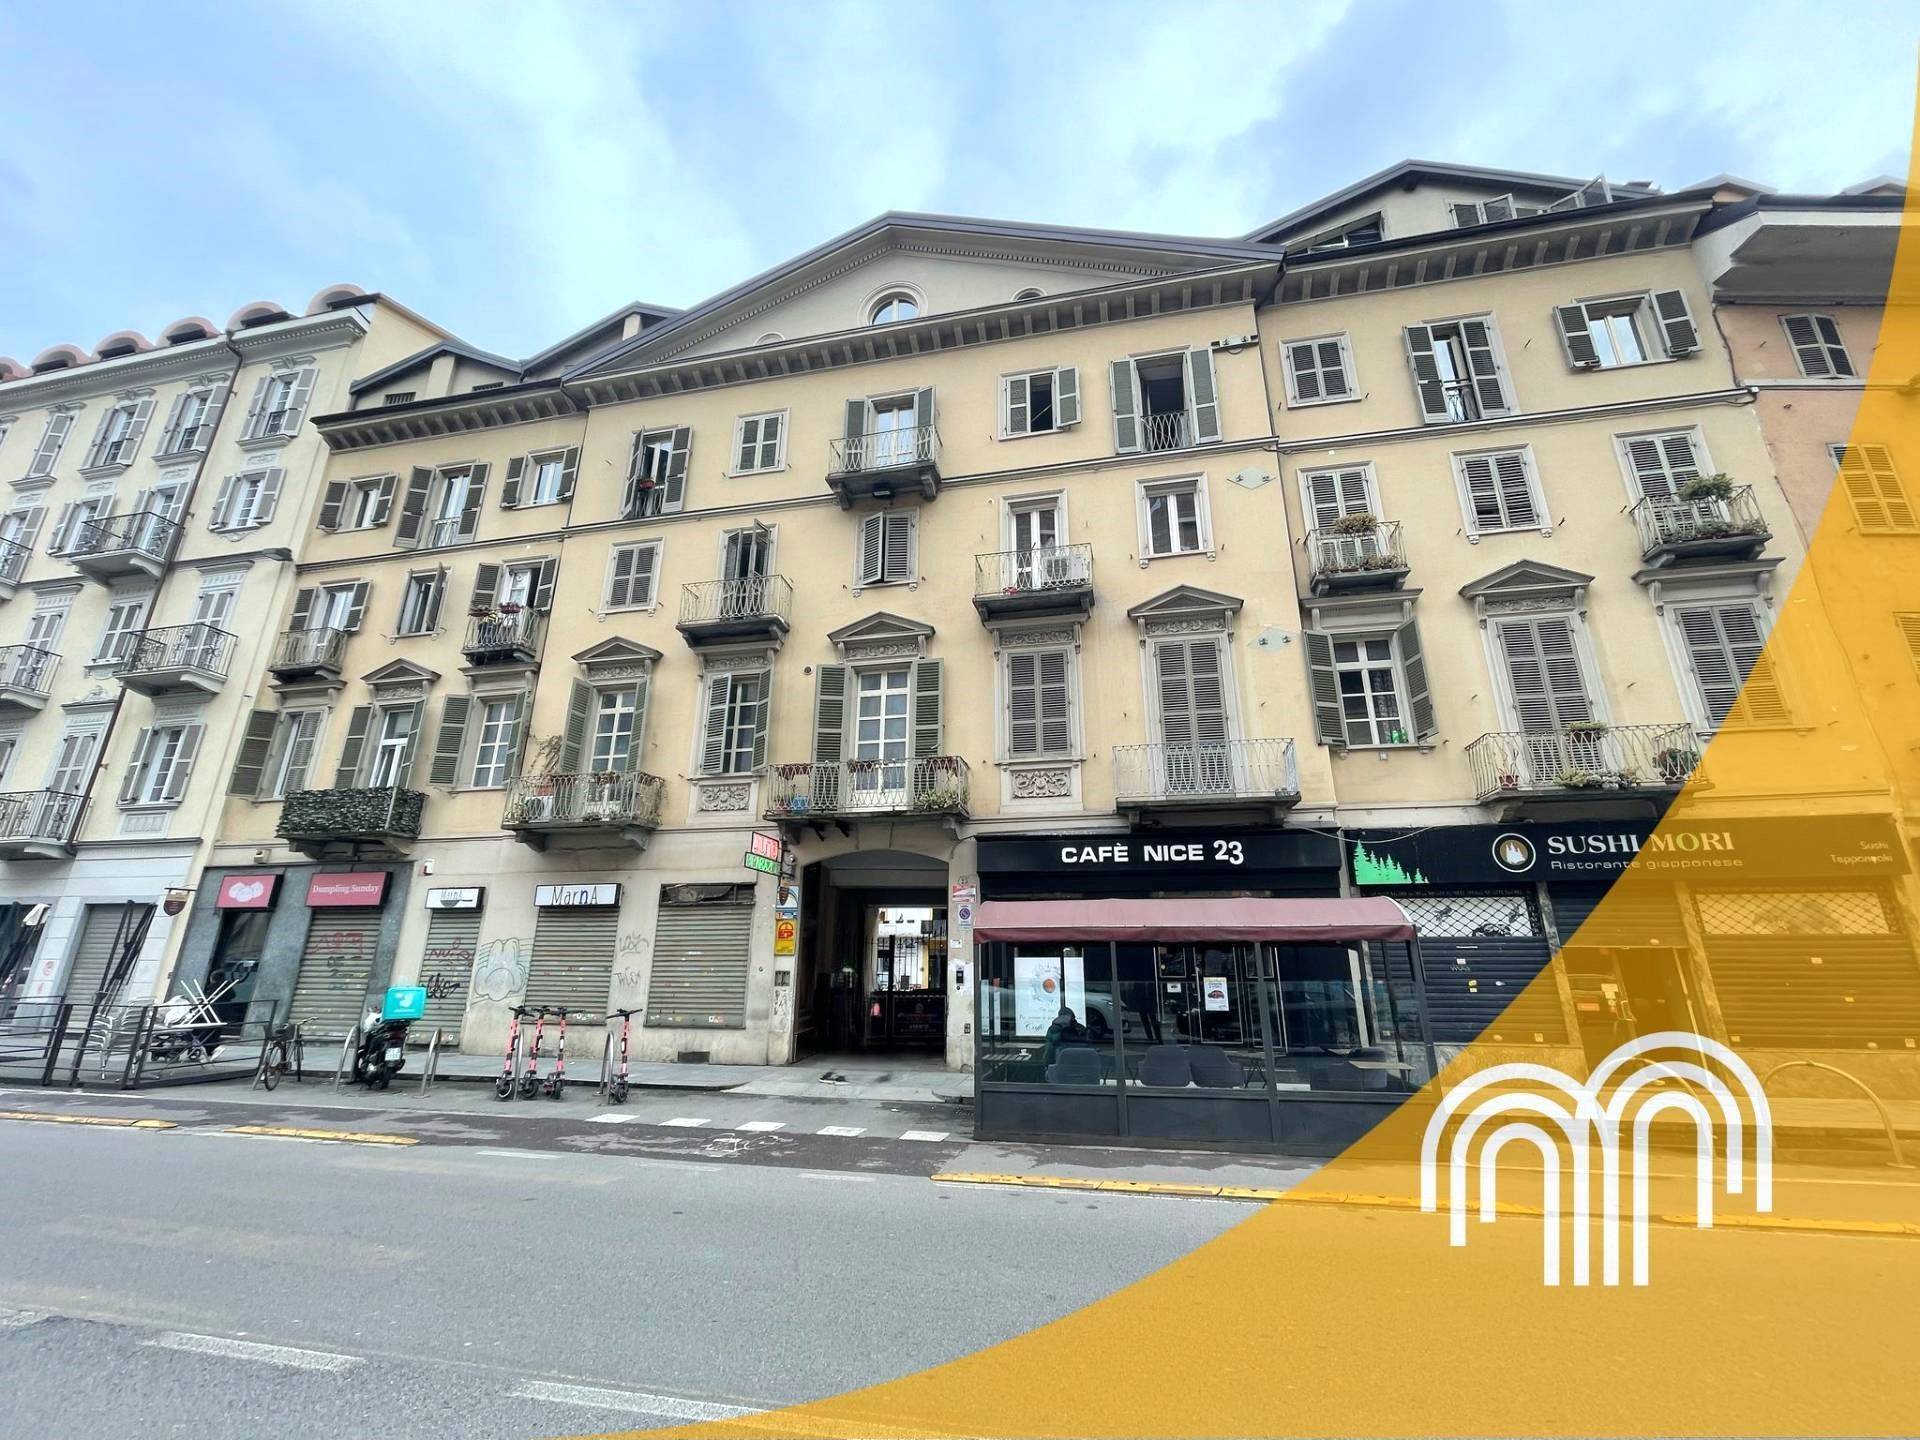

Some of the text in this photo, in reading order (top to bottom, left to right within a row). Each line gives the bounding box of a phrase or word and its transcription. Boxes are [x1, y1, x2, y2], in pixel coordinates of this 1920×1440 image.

[1547, 832, 1736, 854] SUSHI MORI
[1061, 839, 1244, 865] CAFÈ NICE 23
[1550, 859, 1745, 871] Ristorante giapponese
[312, 884, 378, 896] Dumpling Sunday
